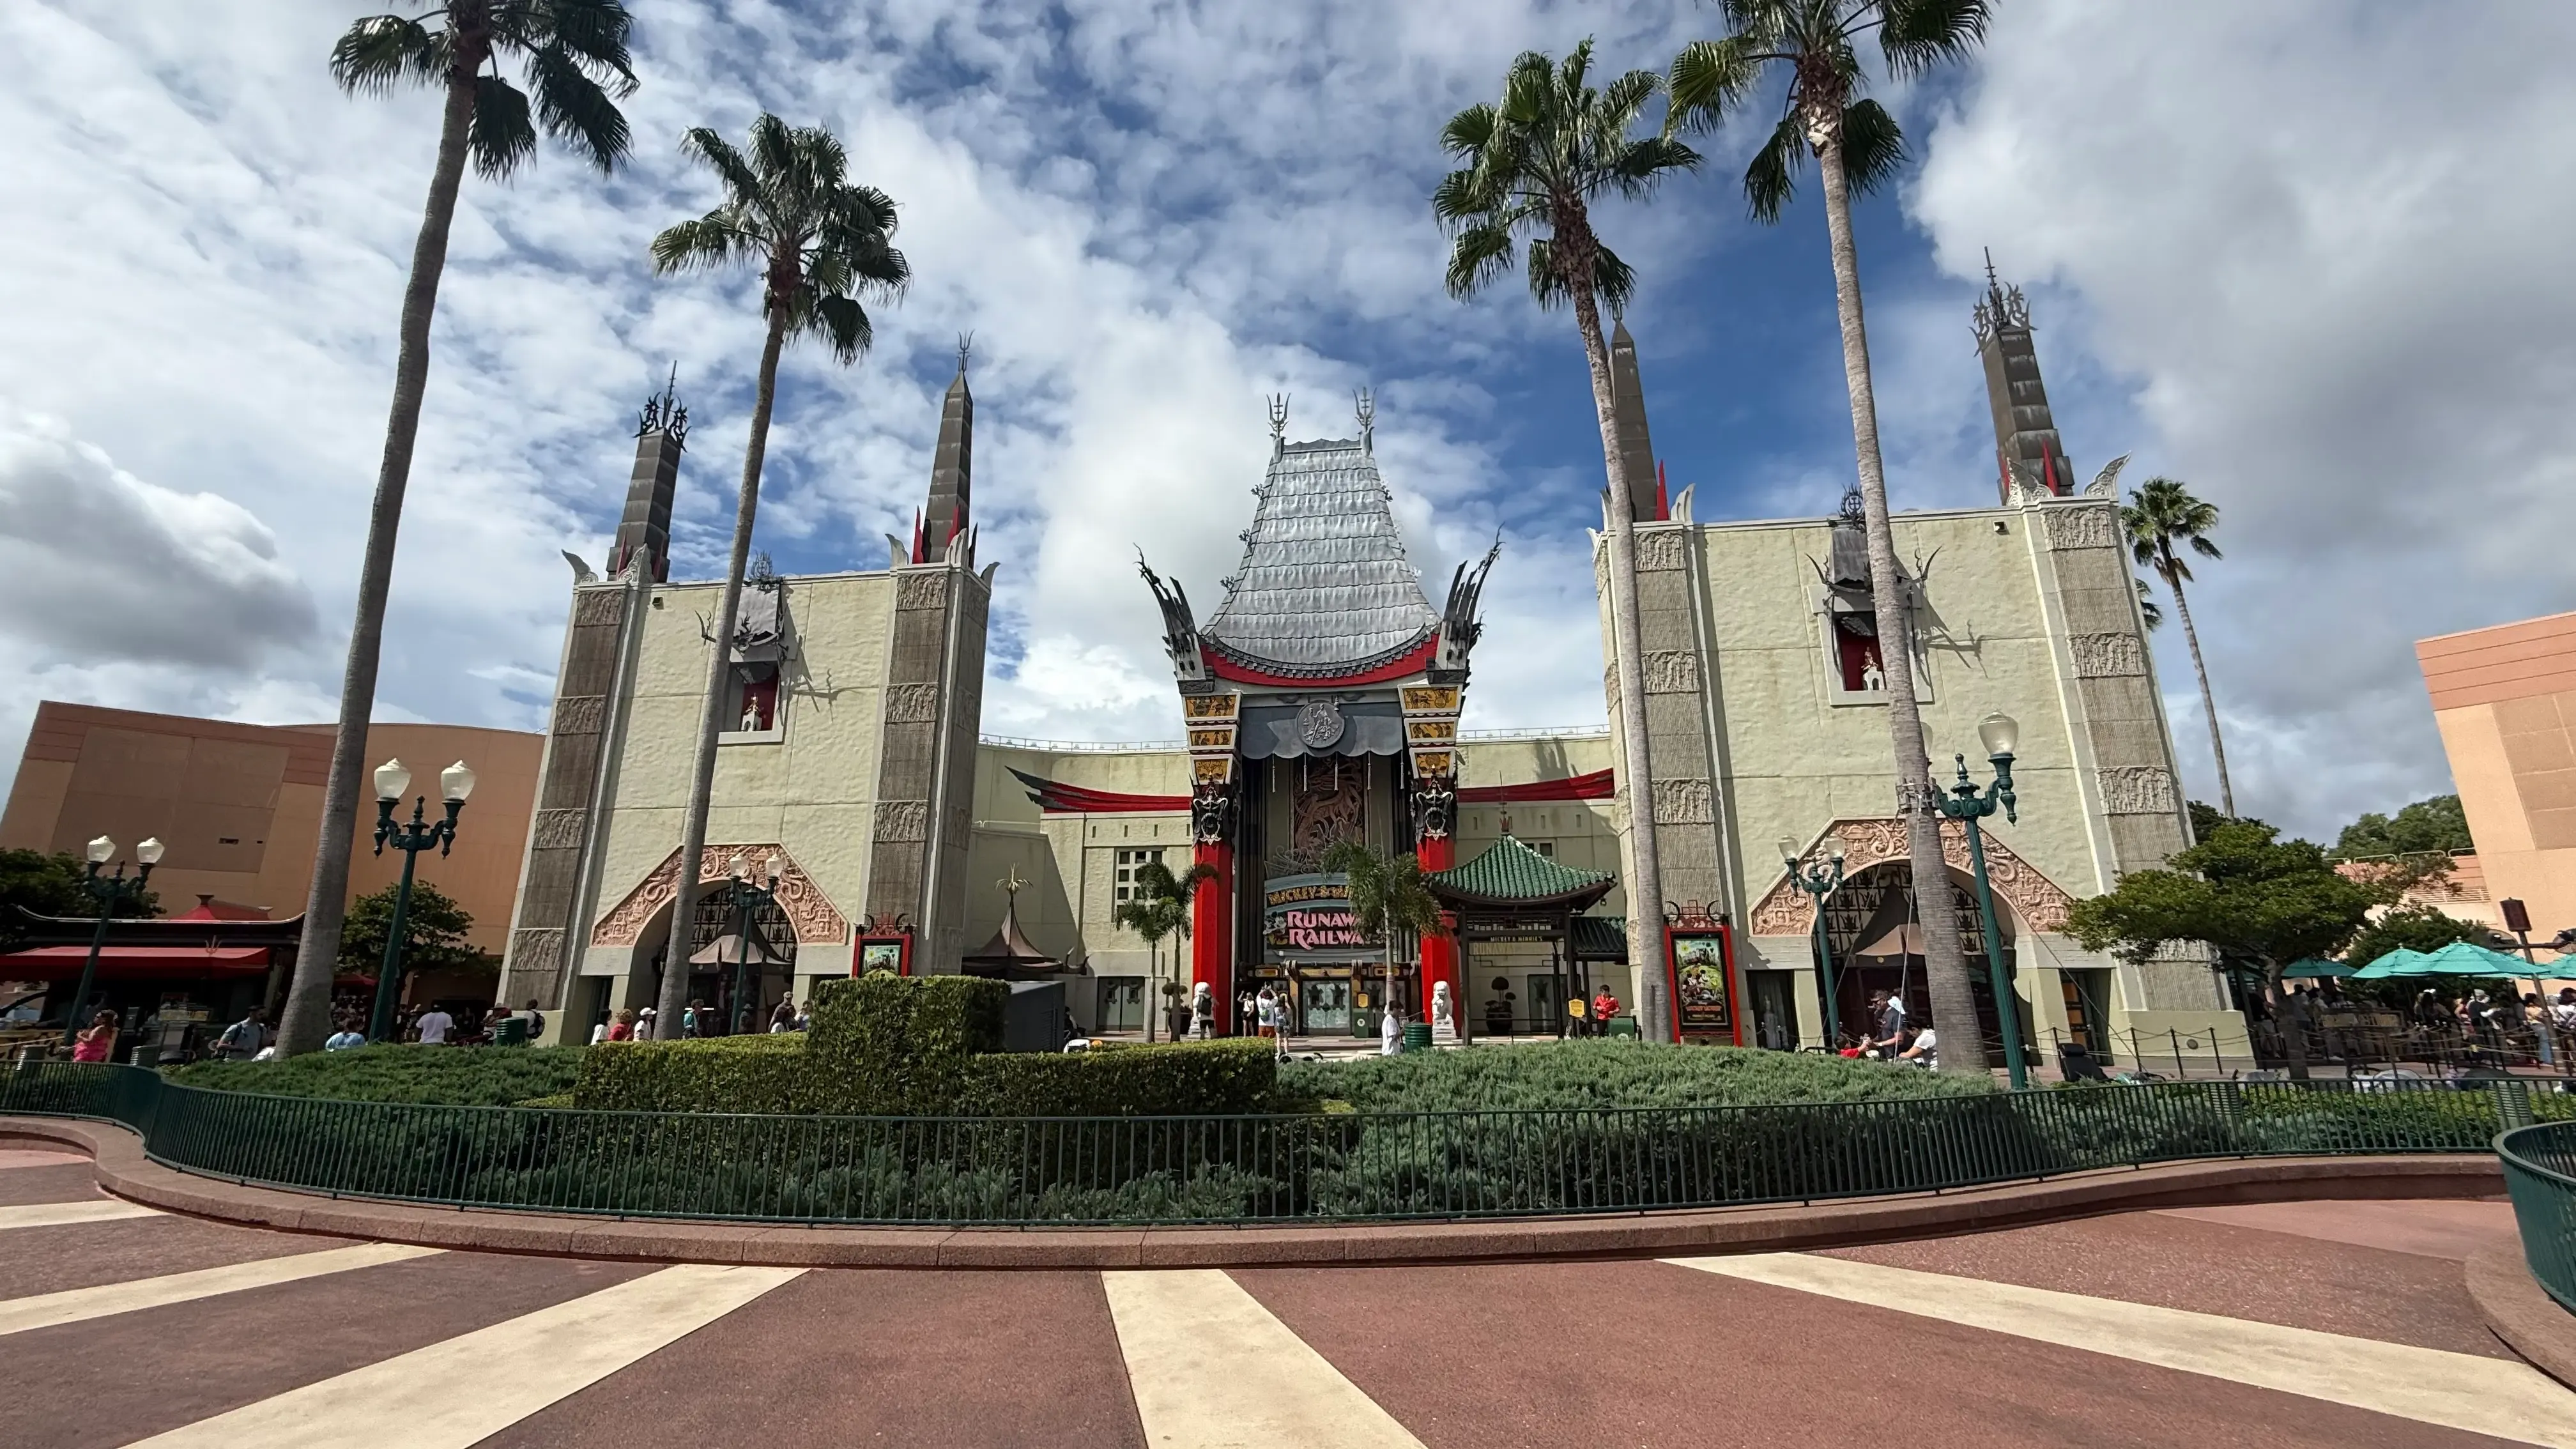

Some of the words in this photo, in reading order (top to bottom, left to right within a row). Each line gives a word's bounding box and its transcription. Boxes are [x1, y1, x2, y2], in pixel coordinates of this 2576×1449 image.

[1268, 885, 1317, 905] MICKEY
[1287, 911, 1358, 928] RUNAW
[1473, 942, 1516, 955] RUNAWA
